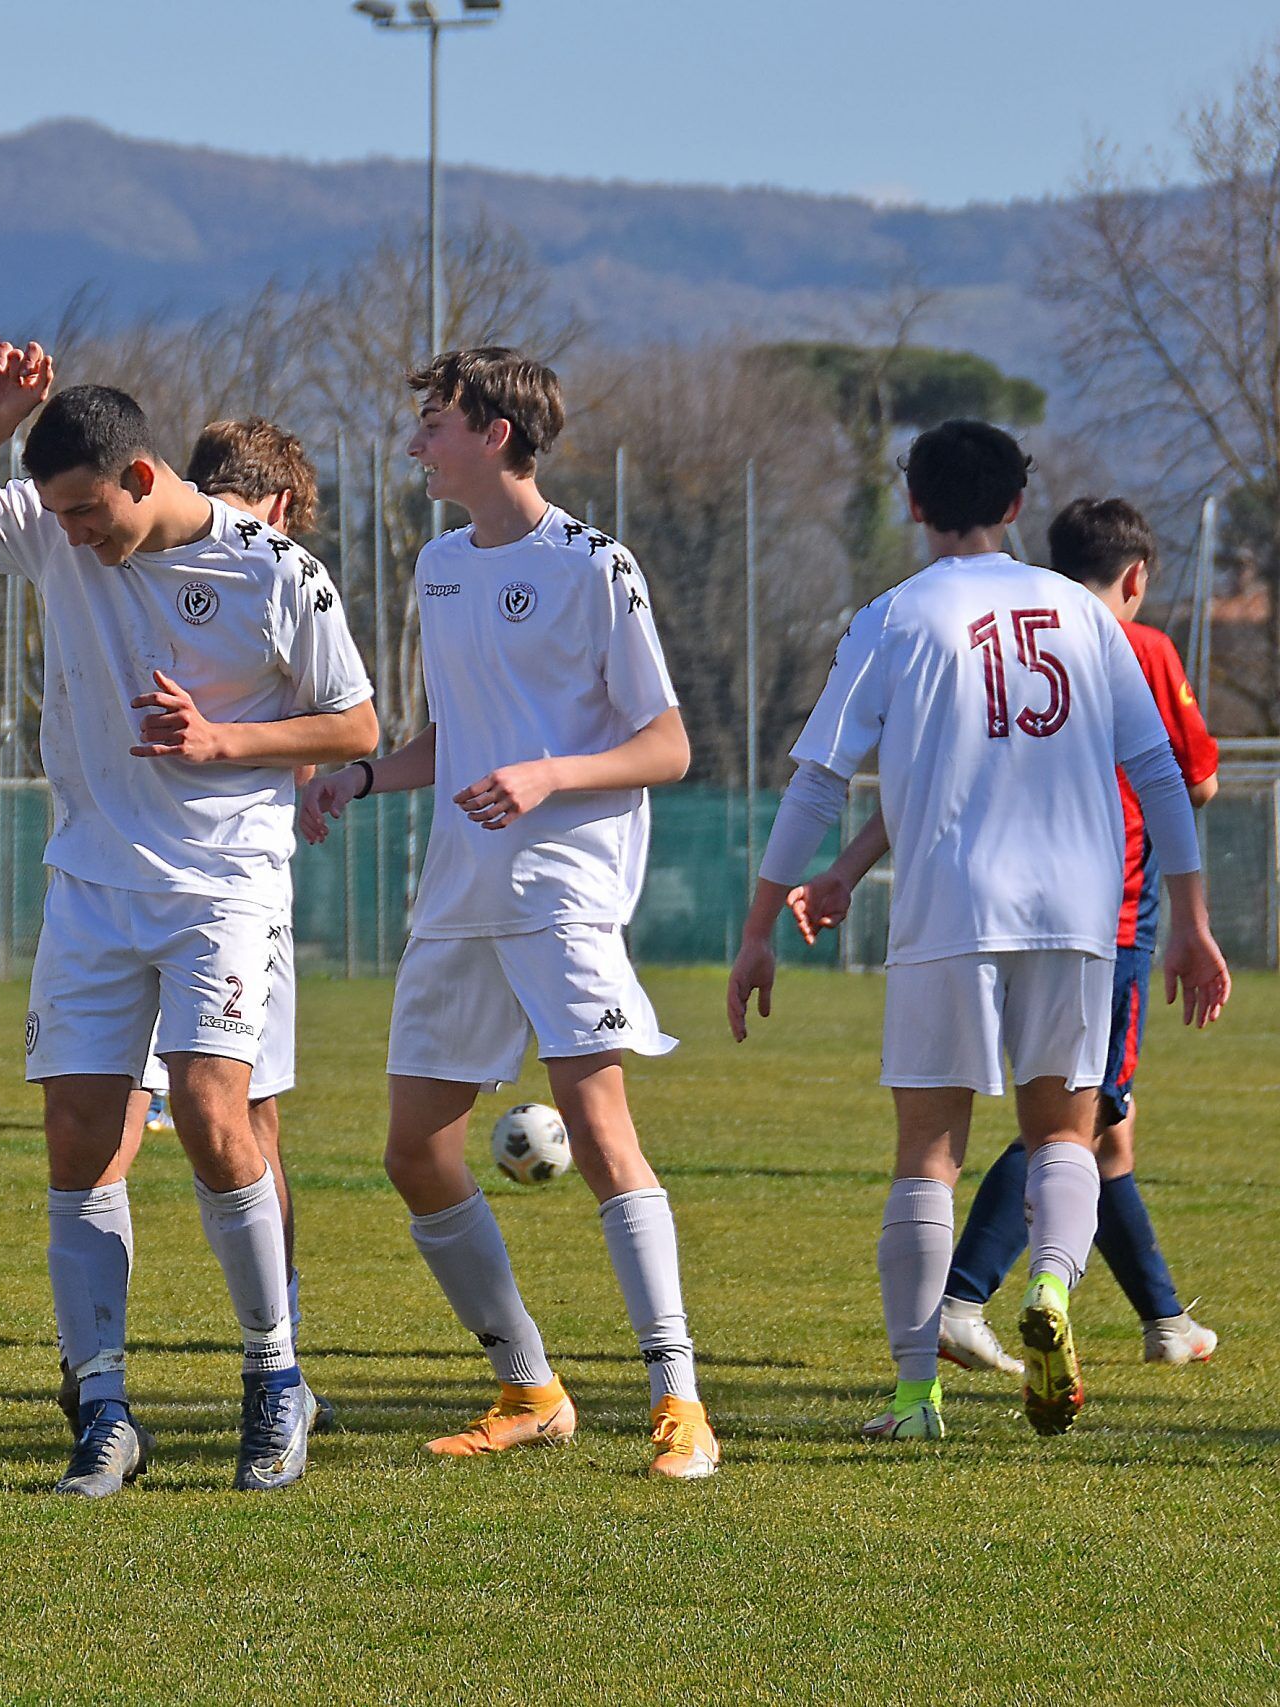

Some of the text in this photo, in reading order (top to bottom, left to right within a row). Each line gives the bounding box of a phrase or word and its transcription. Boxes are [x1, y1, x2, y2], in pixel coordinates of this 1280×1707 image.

[424, 583, 461, 597] Kappa
[967, 609, 1071, 738] 15
[222, 975, 243, 1019] 2
[199, 1014, 255, 1036] Kappa
